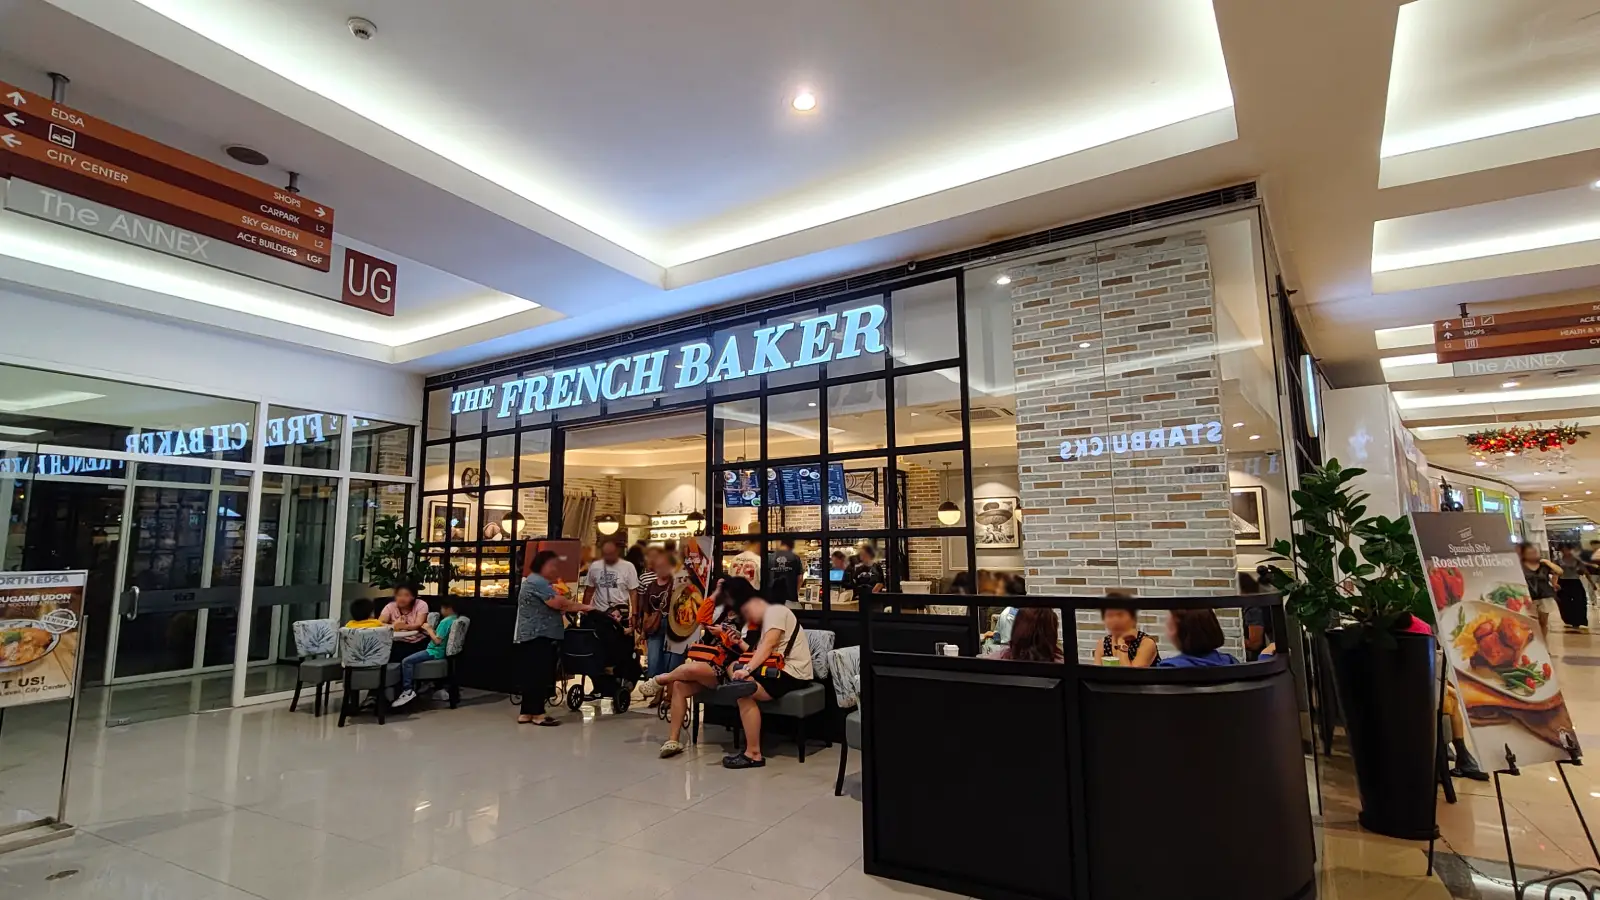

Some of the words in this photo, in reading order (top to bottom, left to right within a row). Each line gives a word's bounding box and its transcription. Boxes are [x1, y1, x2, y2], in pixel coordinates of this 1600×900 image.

[51, 107, 85, 128] EDSA
[46, 148, 77, 168] CITY
[80, 160, 129, 184] CENTER
[273, 191, 302, 209] SHOPS
[39, 189, 100, 227] The
[108, 214, 211, 260] ANNEX
[260, 204, 301, 225] CARPARK
[315, 223, 326, 234] L2
[241, 215, 259, 230] SKY
[260, 221, 300, 241] GARDEN
[314, 239, 324, 249] L2
[237, 231, 258, 246] ACE
[259, 237, 298, 257] BUILDERS
[306, 253, 323, 266] LGF
[348, 258, 393, 304] UG
[450, 385, 496, 415] THE
[496, 349, 670, 419] FRENCH
[674, 303, 888, 390] BAKER
[1467, 361, 1498, 374] The
[1504, 352, 1567, 371] ANNEX
[1448, 543, 1475, 555] Spanish
[1475, 543, 1491, 554] Style
[1431, 555, 1474, 568] Roasted
[1474, 553, 1514, 567] Chicken
[36, 575, 69, 584] EDSA
[41, 593, 72, 601] UDON
[18, 676, 46, 687] US!
